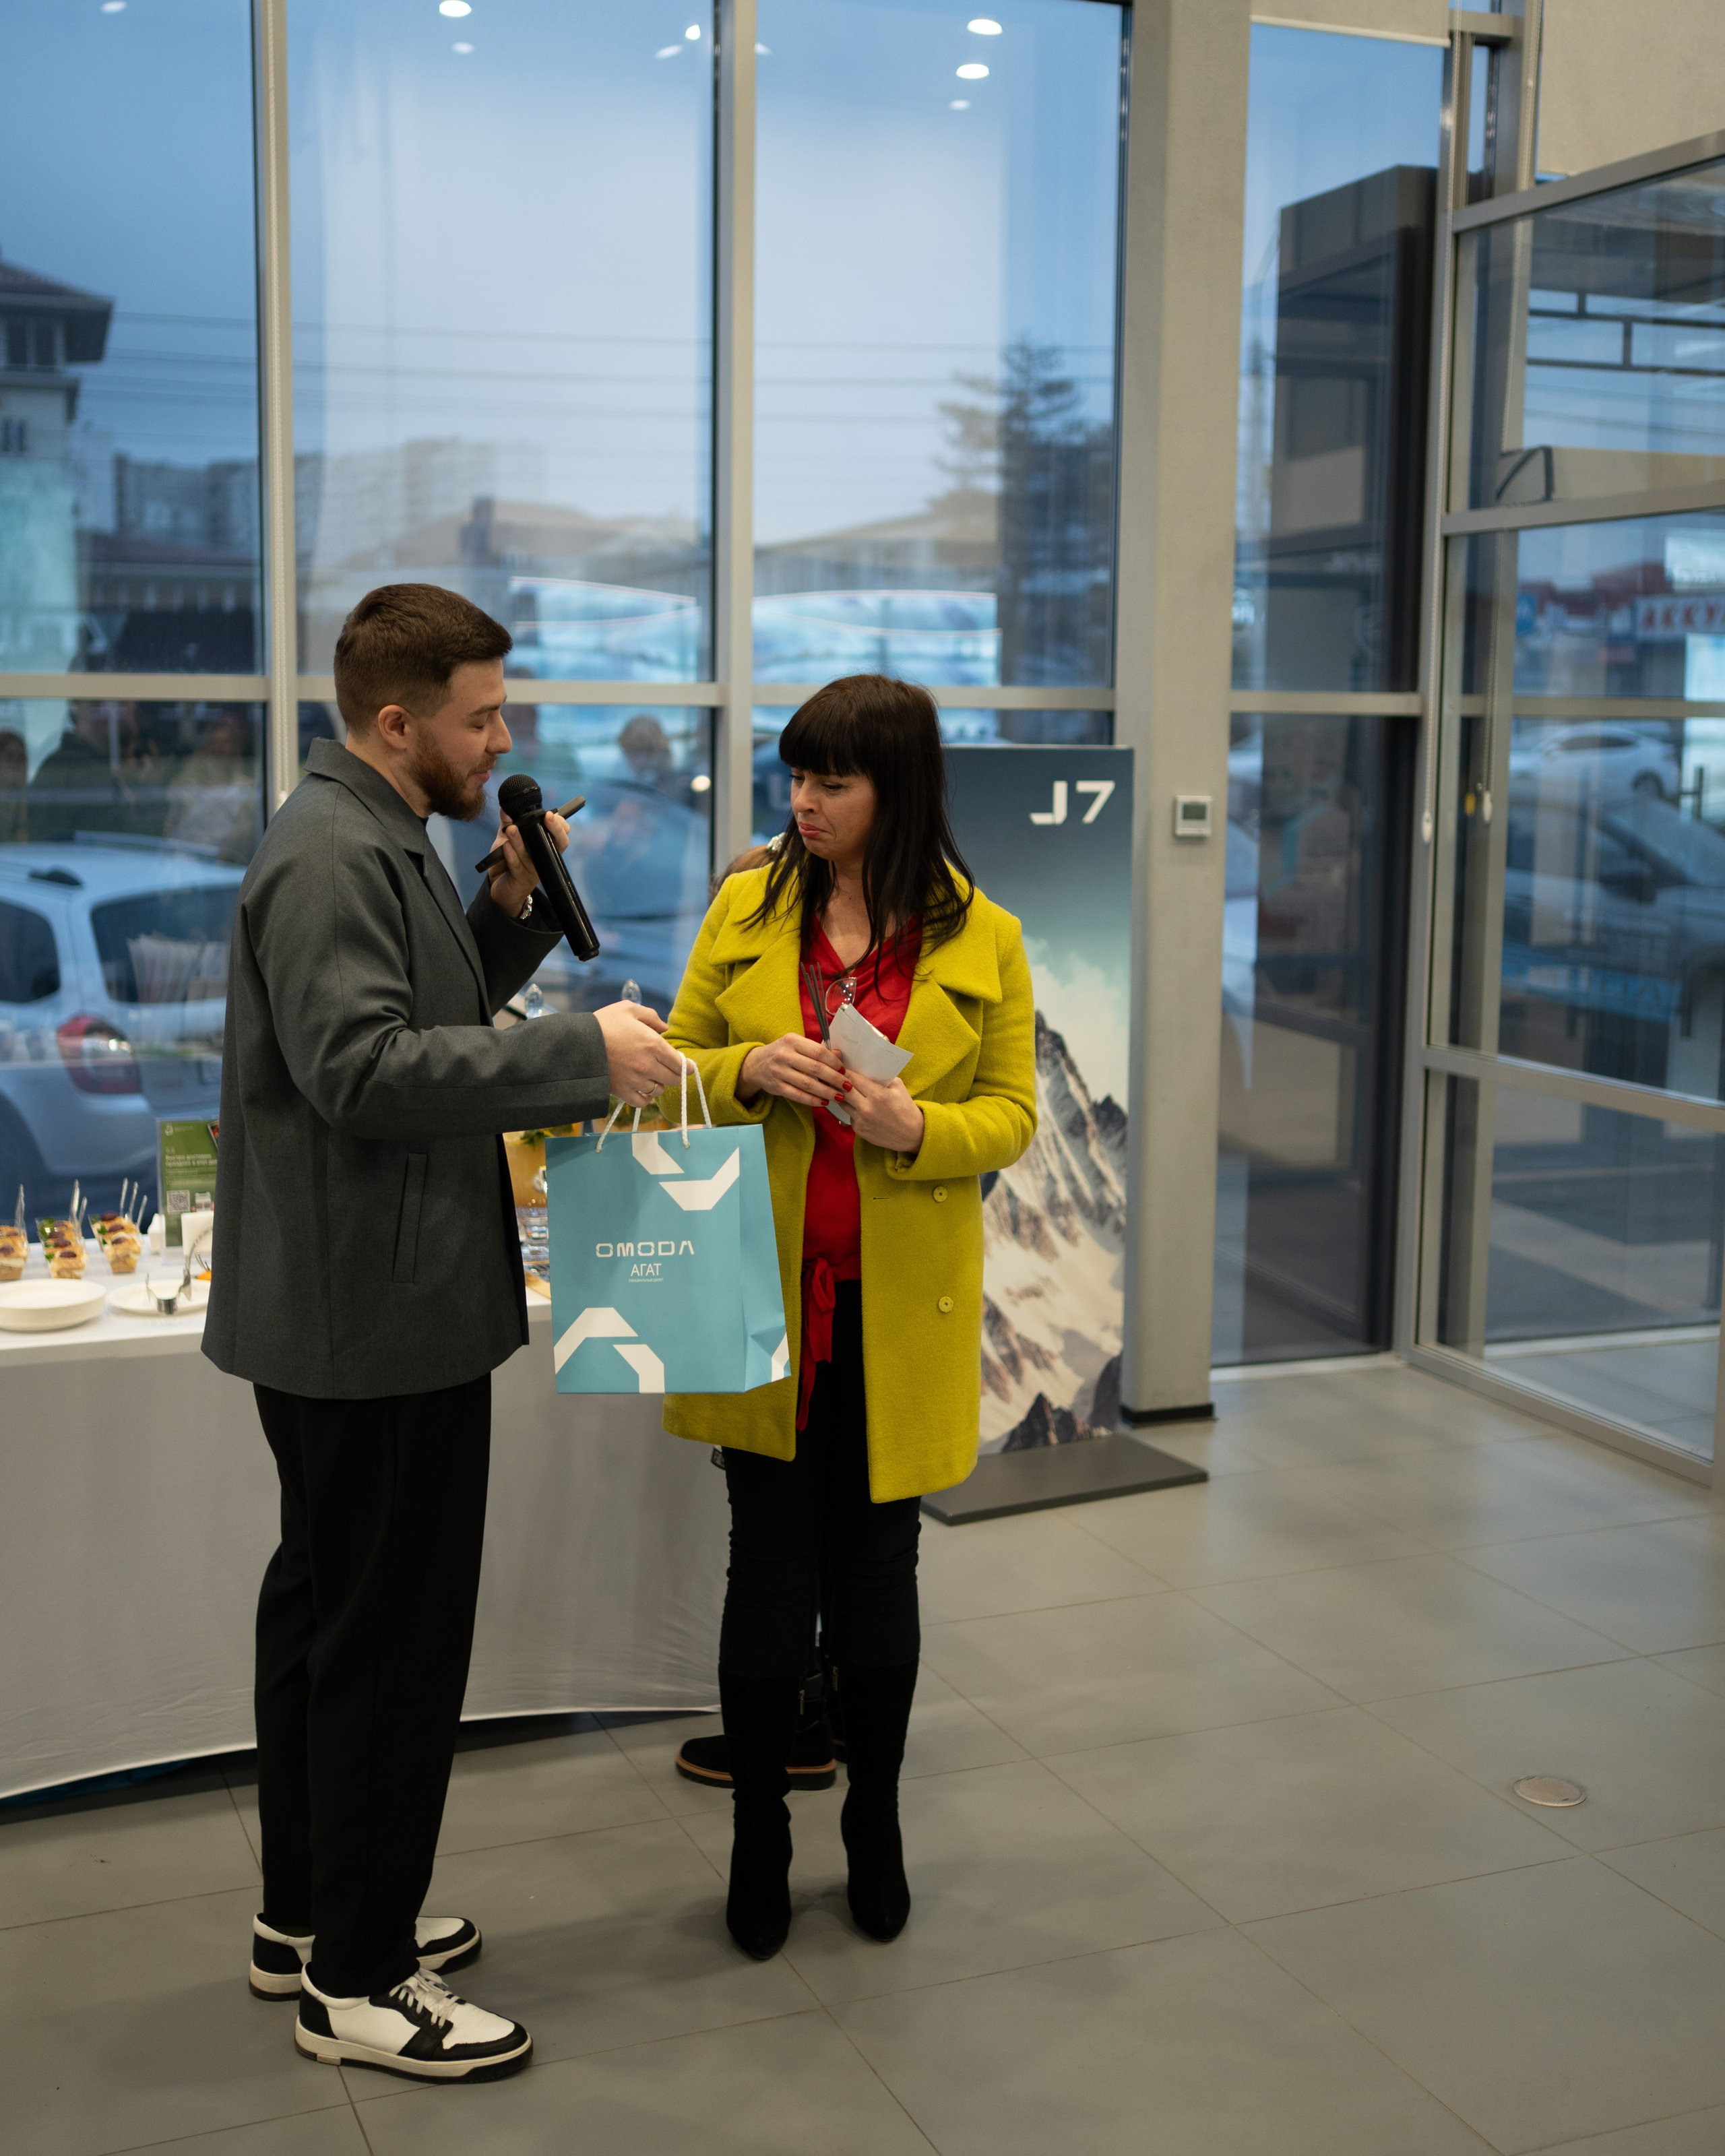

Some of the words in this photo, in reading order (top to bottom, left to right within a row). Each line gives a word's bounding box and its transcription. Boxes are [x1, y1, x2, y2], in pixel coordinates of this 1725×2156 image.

[1643, 606, 1725, 629] АККУ
[1029, 780, 1116, 825] J7
[596, 1240, 695, 1258] OMODA
[630, 1263, 662, 1277] АГАТ
